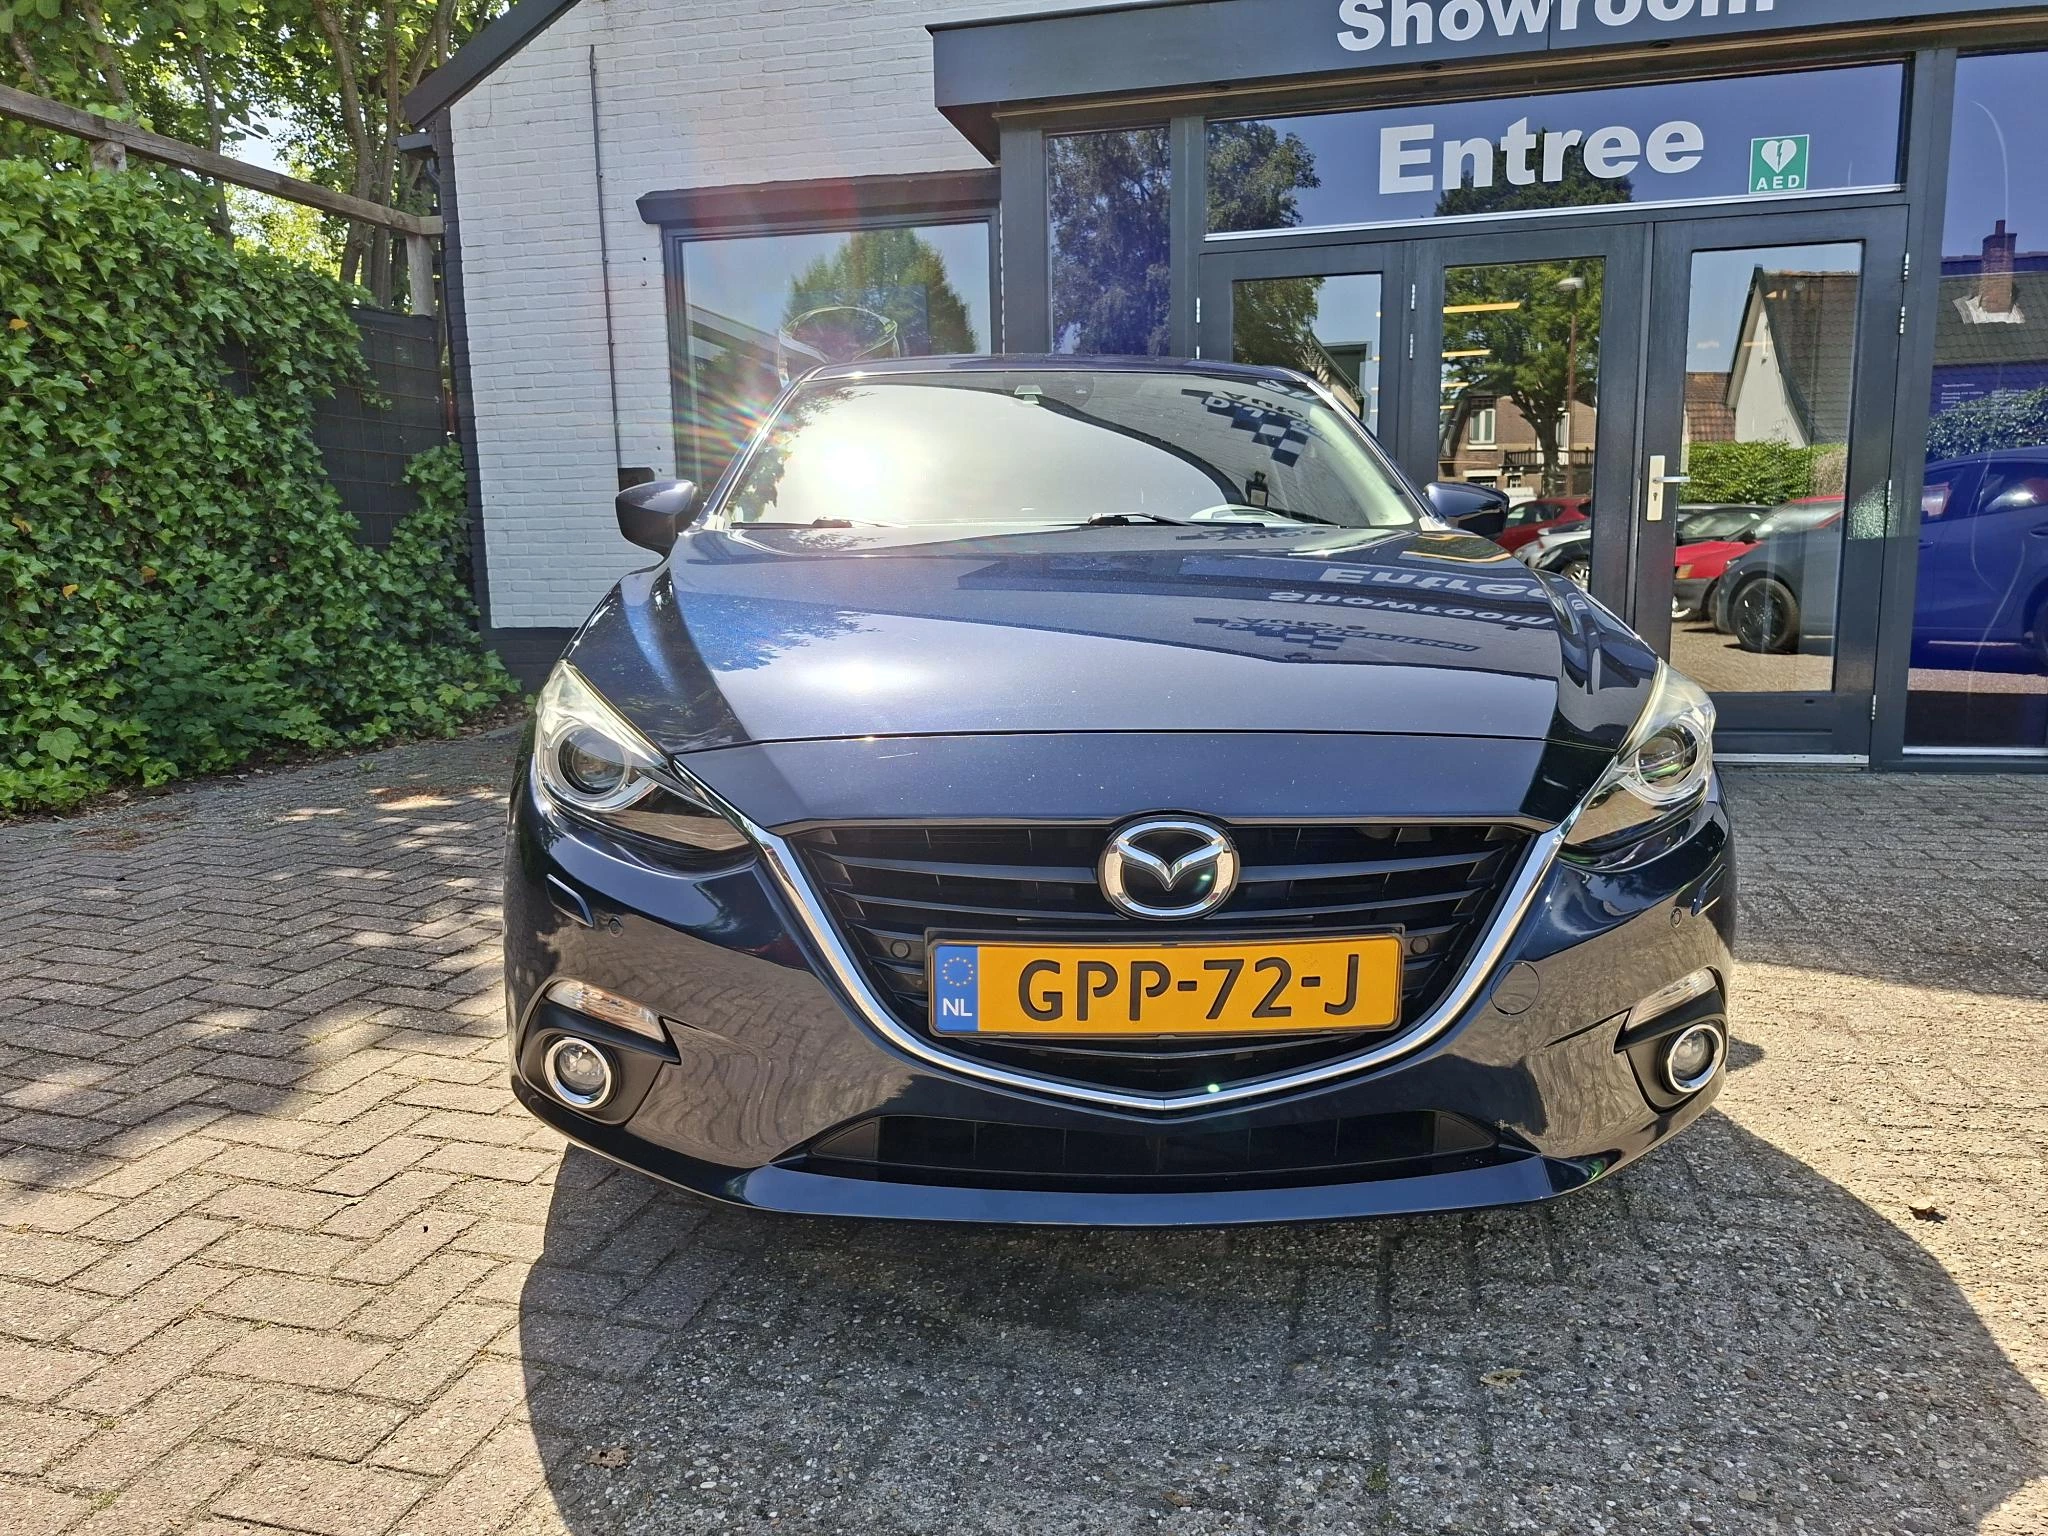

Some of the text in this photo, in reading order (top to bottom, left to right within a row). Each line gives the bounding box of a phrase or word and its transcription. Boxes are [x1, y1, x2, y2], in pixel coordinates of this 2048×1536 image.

[1379, 117, 1704, 195] Entree
[1756, 175, 1800, 190] AED
[942, 998, 973, 1017] NL
[1018, 954, 1359, 1021] GPP-72-J
